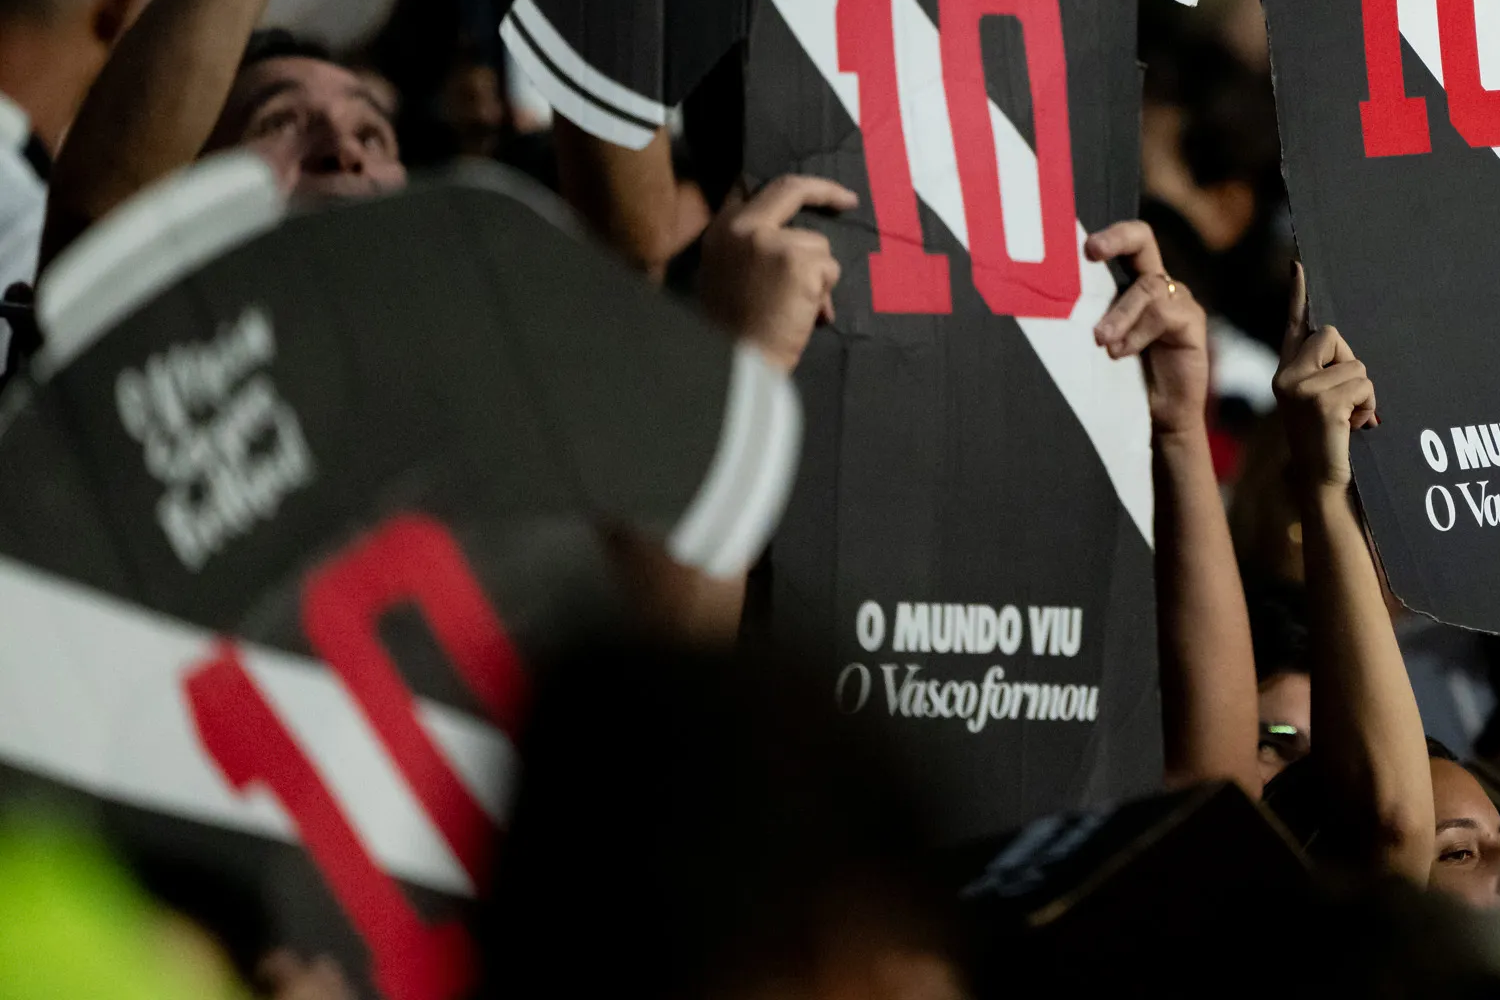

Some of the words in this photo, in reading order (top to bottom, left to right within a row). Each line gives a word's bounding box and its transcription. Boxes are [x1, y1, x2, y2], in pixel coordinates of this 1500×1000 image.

[1420, 429, 1449, 473] O
[1425, 485, 1456, 532] O
[856, 600, 885, 652] O
[892, 602, 1022, 655] MUNDO
[1028, 605, 1082, 657] VIU
[834, 662, 871, 715] O
